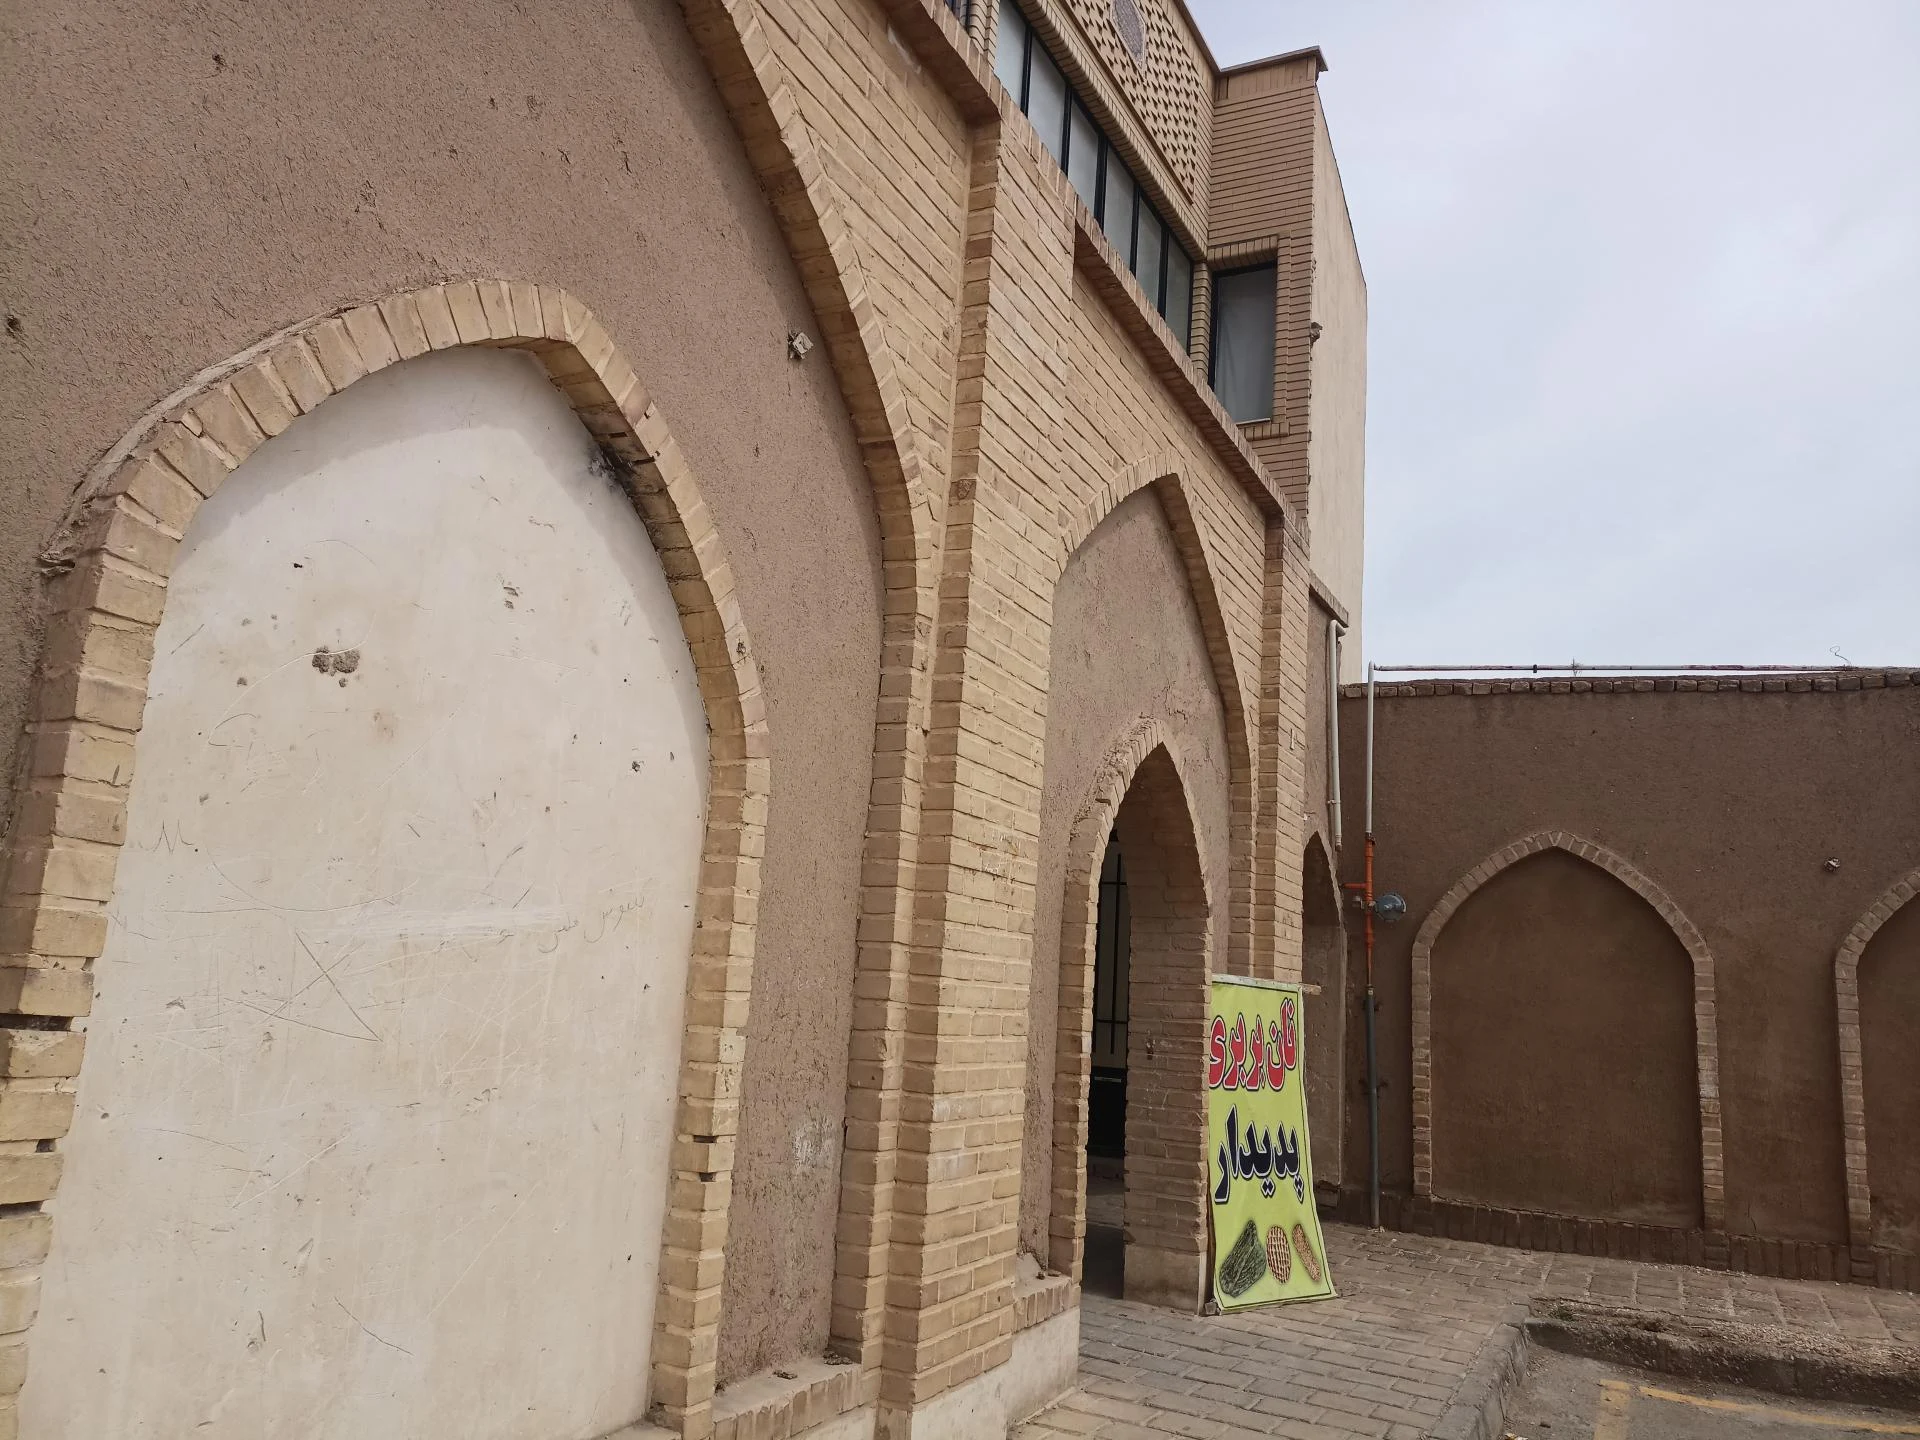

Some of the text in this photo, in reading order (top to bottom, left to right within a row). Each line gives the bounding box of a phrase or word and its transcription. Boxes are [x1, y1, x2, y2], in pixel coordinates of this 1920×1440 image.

[1208, 997, 1296, 1092] نان بربری
[1213, 1103, 1304, 1205] پدیدار
